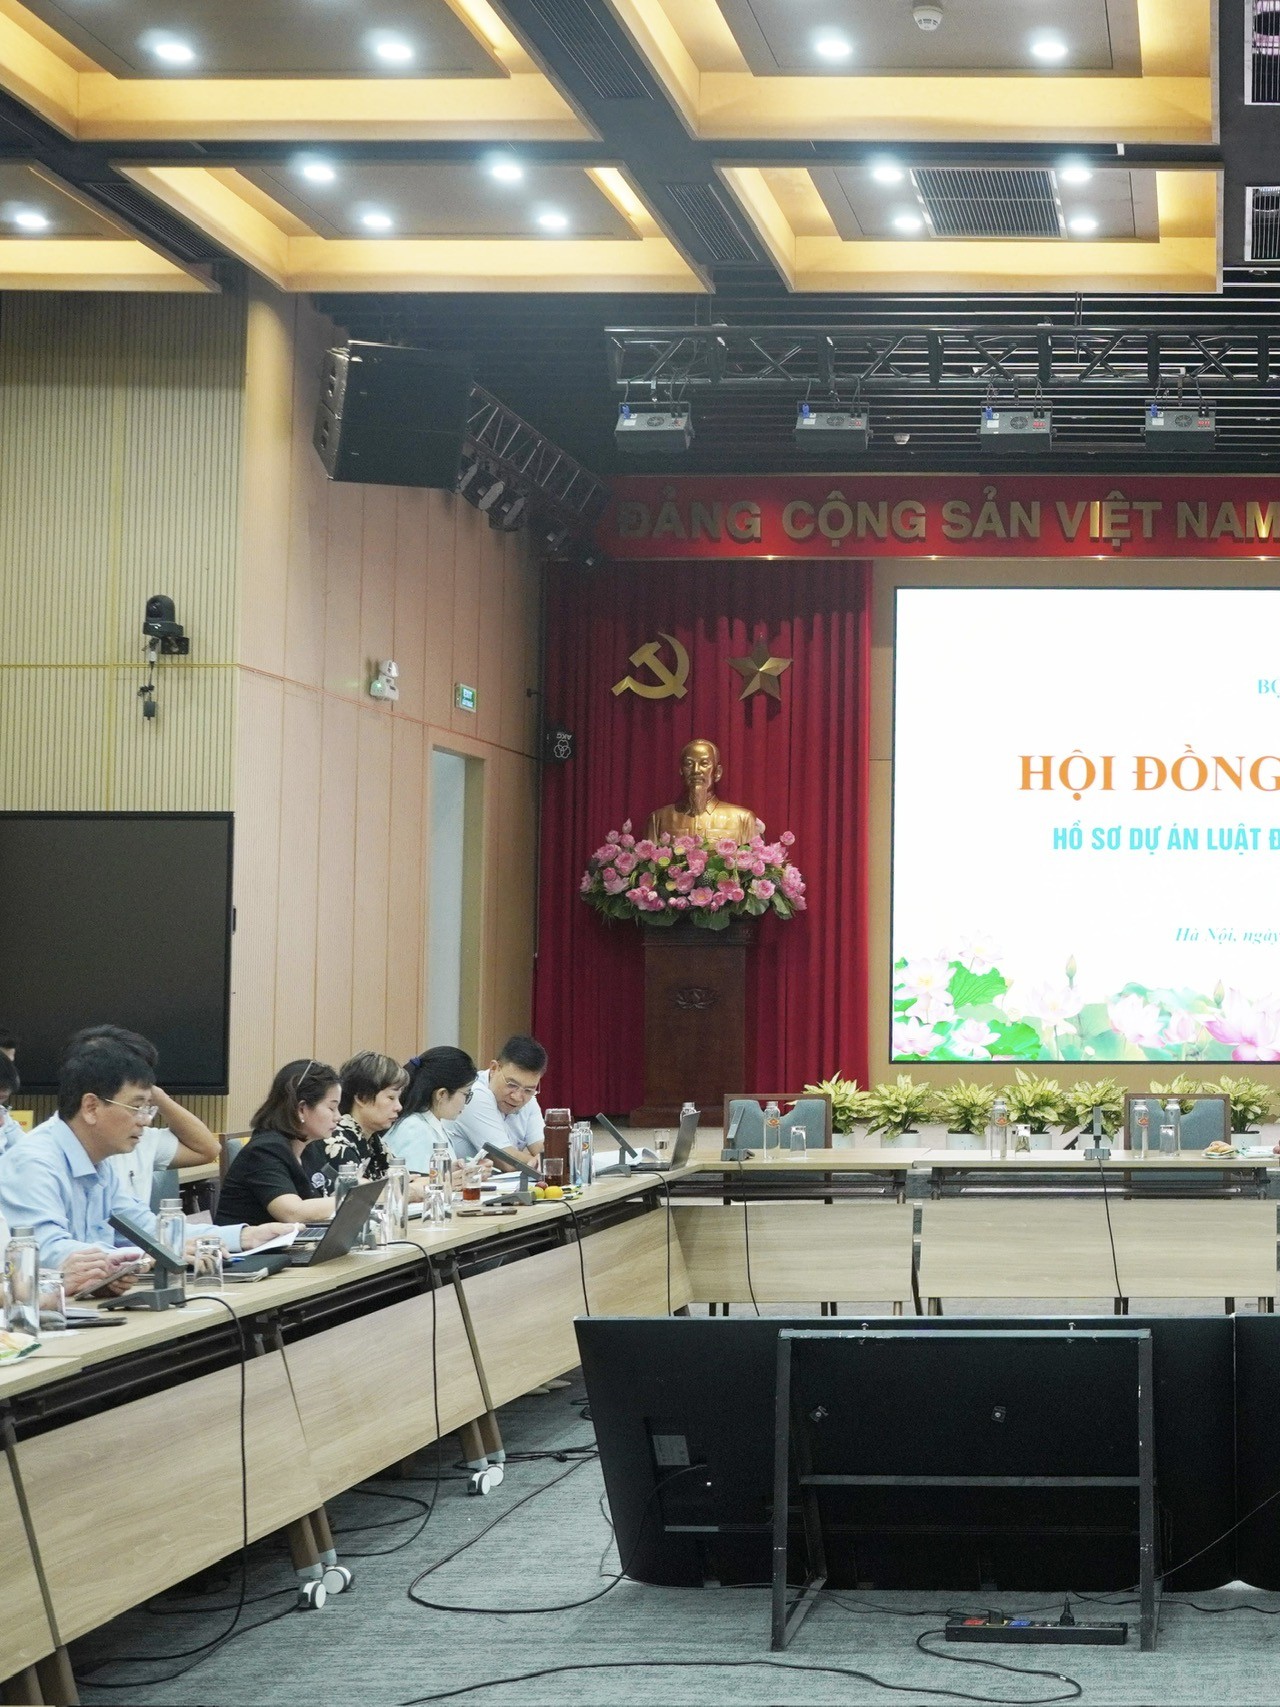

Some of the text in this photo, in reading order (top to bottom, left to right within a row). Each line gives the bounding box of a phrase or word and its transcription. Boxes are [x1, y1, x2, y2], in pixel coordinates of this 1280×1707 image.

[617, 485, 762, 541] ĐẢNG
[782, 490, 926, 547] CỘNG
[941, 485, 1041, 539] SẢN
[1056, 490, 1163, 547] VIỆT
[1017, 749, 1116, 801] HỘI
[1053, 820, 1084, 851] HỒ
[1091, 825, 1122, 851] SƠ
[1129, 825, 1162, 855] DỰ
[1167, 823, 1199, 851] ÁN
[1207, 823, 1261, 855] LUẬT
[1175, 927, 1200, 942] Hà
[1205, 927, 1238, 944] Nội,
